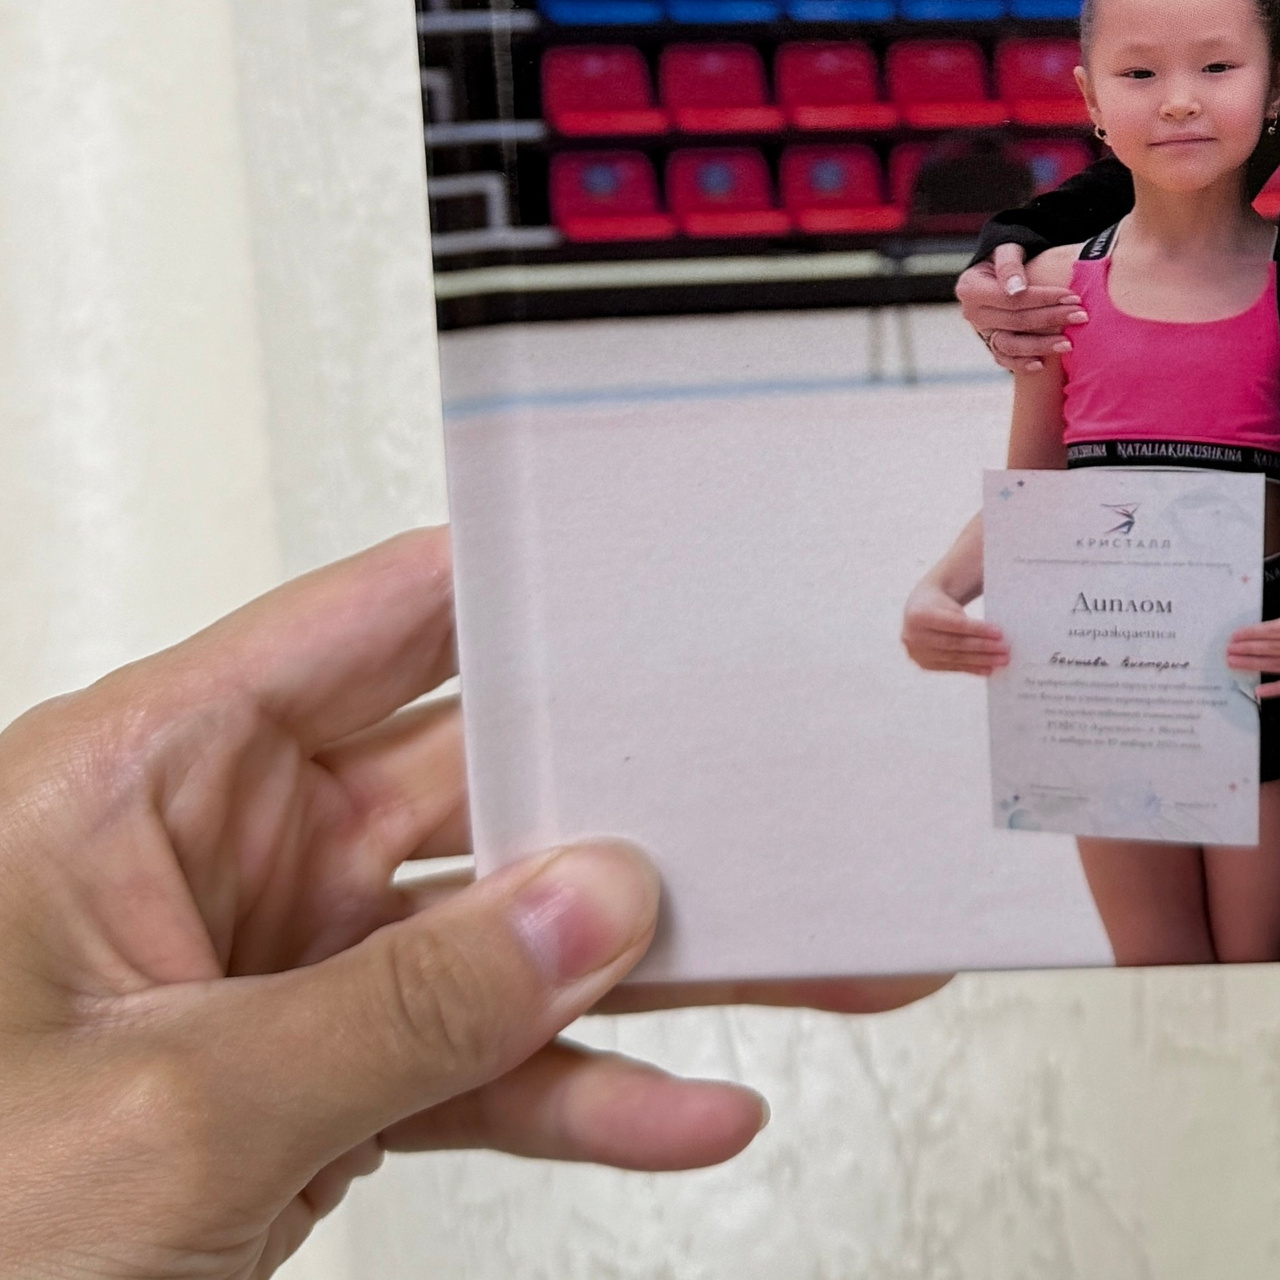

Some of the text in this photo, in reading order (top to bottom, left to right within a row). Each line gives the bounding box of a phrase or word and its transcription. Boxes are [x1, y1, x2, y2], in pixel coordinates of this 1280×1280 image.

[1117, 442, 1242, 462] NATALIAKUKUSHKINA
[1076, 538, 1171, 549] КРИСТАЛЛ
[1071, 591, 1172, 614] Диплом
[1068, 625, 1176, 641] награждается
